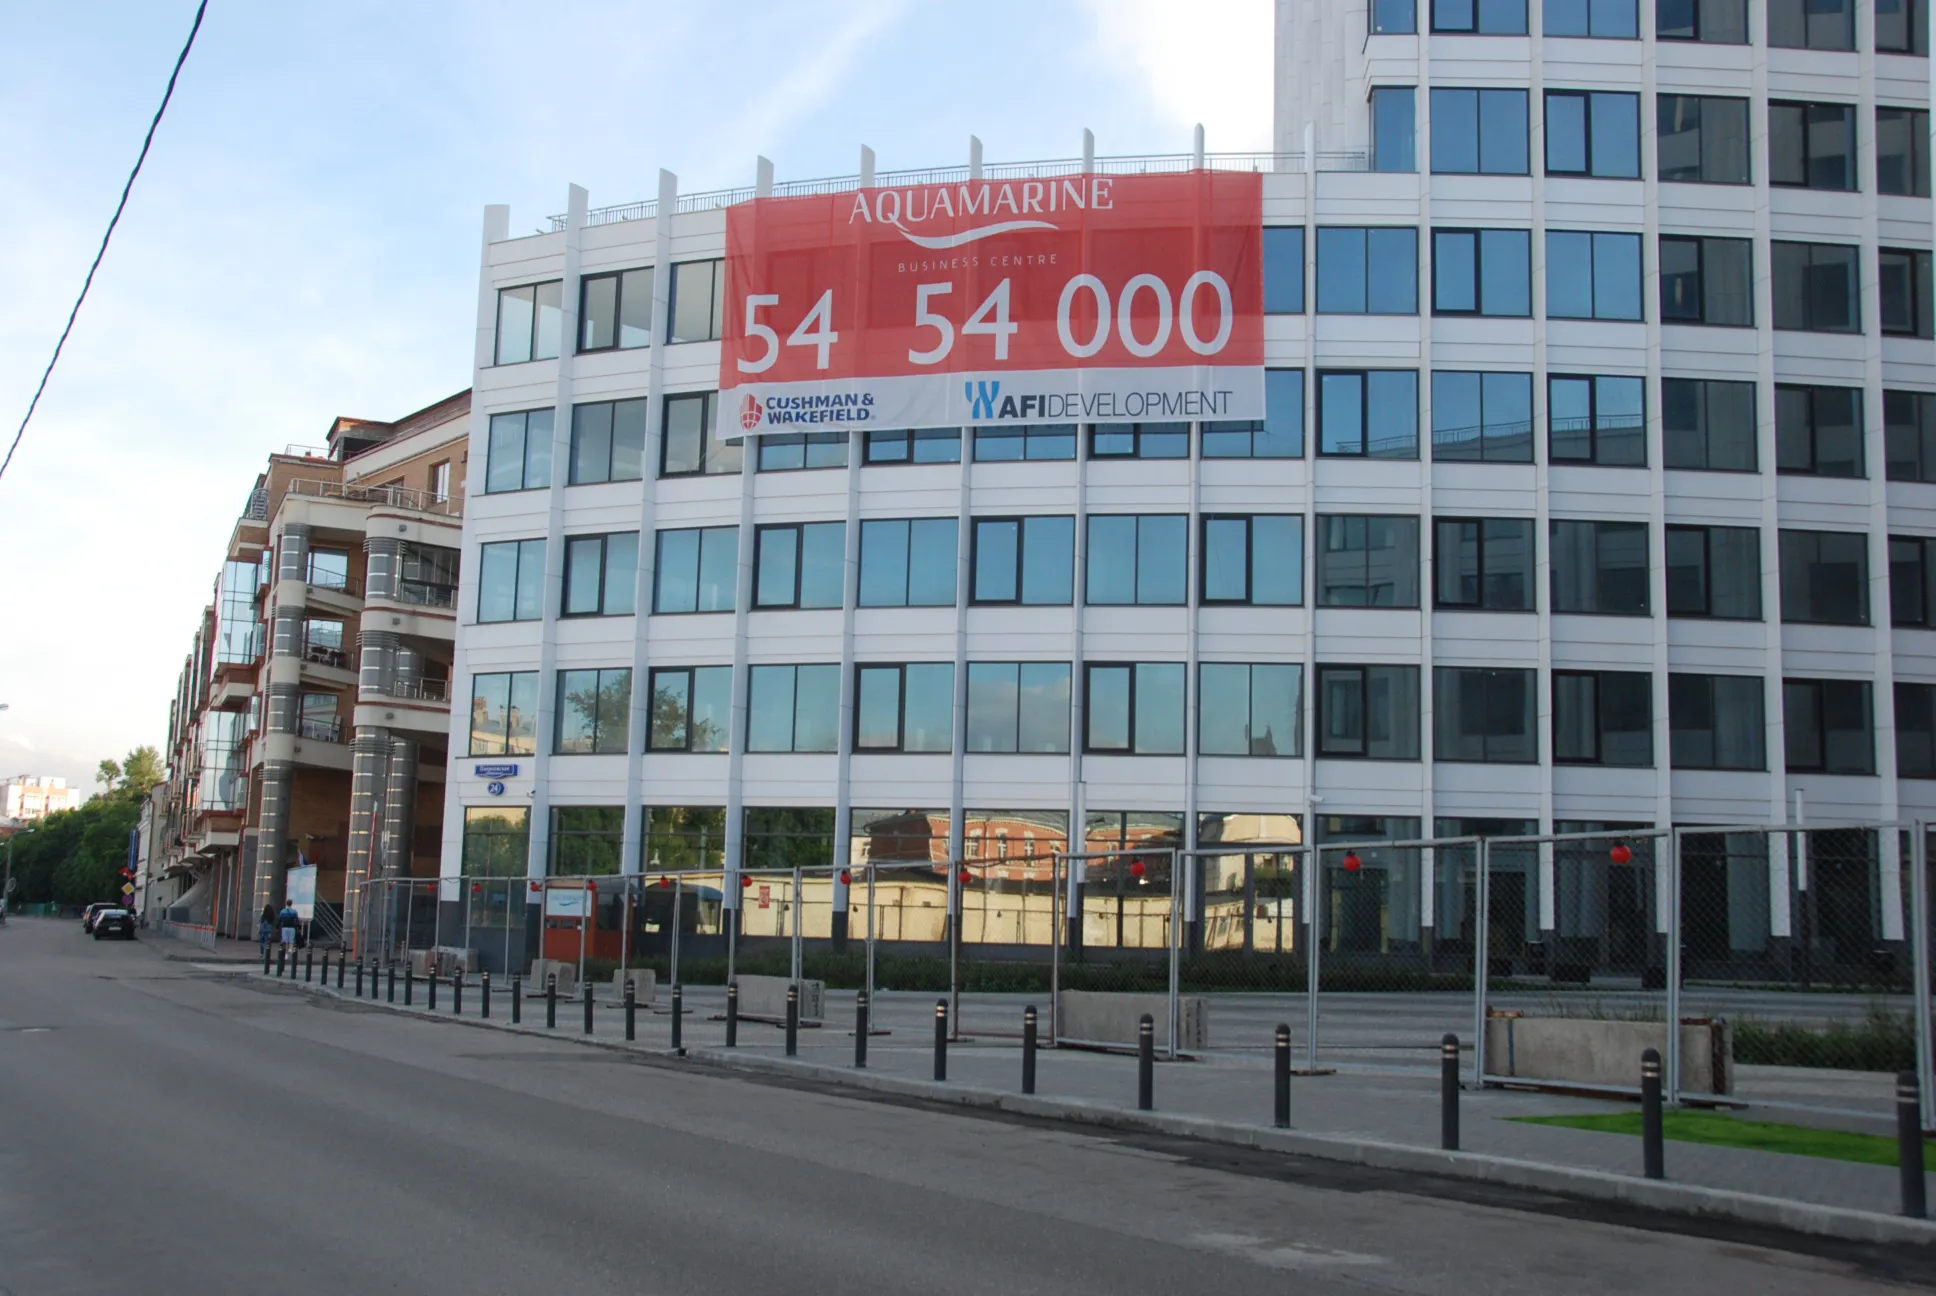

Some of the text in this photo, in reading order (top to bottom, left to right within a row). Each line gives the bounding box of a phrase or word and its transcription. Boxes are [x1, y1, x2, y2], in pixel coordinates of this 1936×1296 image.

[849, 178, 1113, 232] AQUAMARINE
[898, 253, 1058, 273] BUSINESS CENTRE
[737, 269, 1234, 374] 54 54 000
[766, 392, 875, 410] CUSHMAN &
[767, 408, 870, 425] WAKEFIELD
